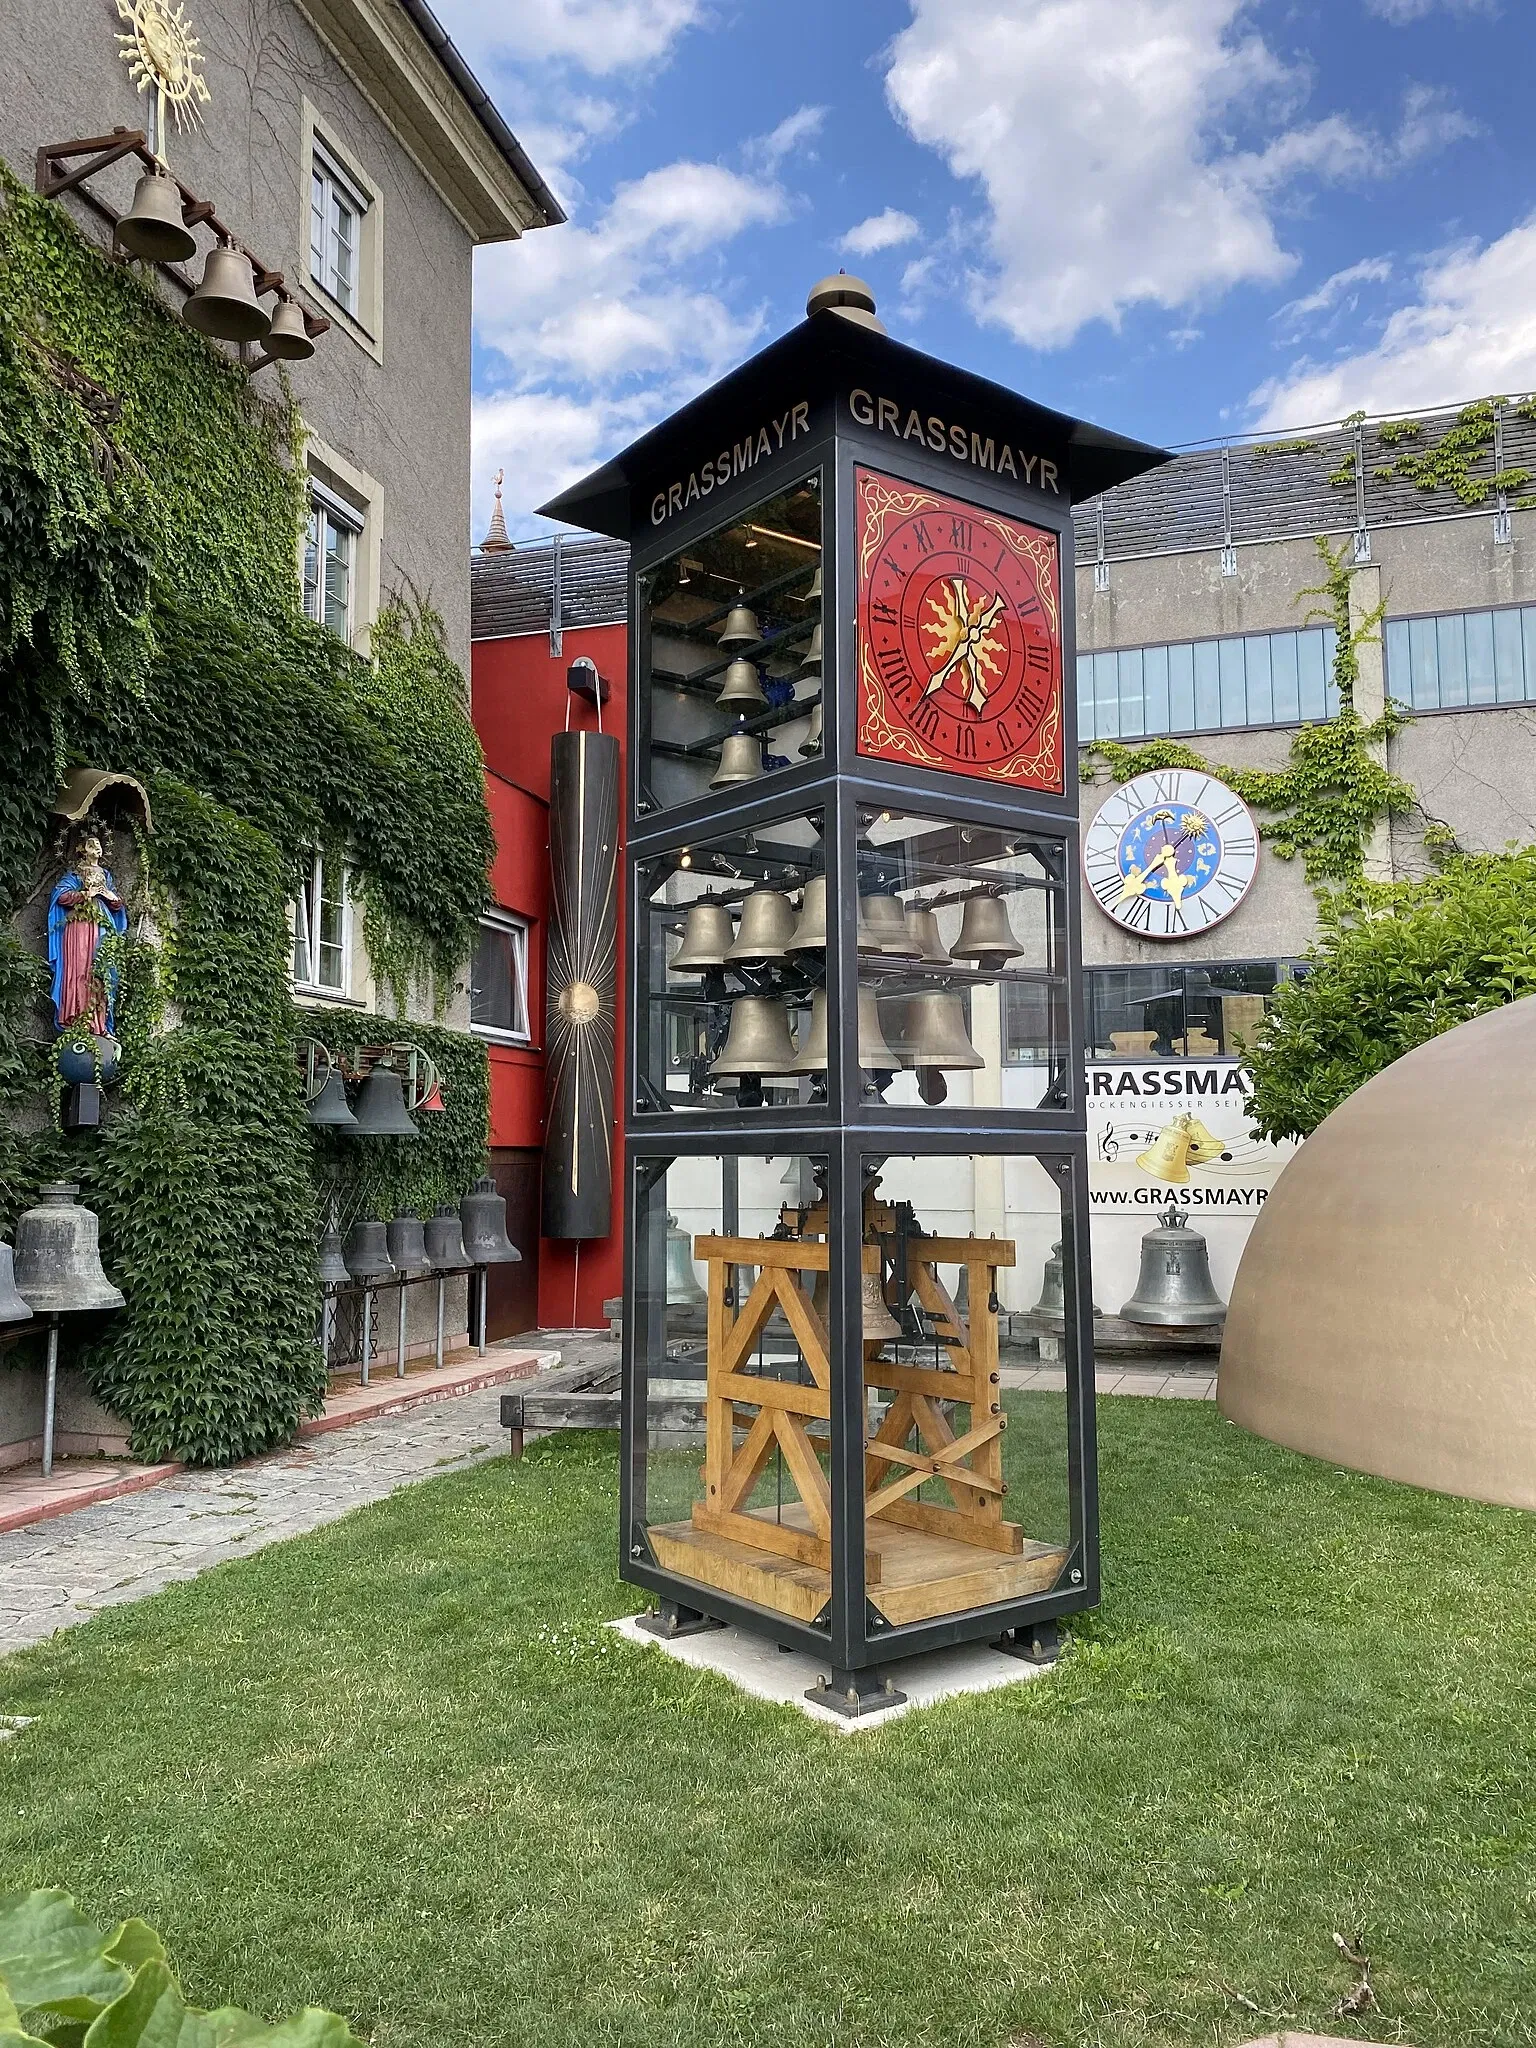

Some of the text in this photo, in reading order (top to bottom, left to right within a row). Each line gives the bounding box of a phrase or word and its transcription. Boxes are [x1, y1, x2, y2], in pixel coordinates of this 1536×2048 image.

[849, 388, 1059, 494] GRASSMAYR
[651, 400, 810, 526] GRASSMAYR
[912, 518, 934, 553] XI
[949, 517, 973, 552] XII
[882, 553, 907, 582] X
[994, 548, 1006, 572] I
[871, 597, 899, 626] IX
[1017, 596, 1041, 617] II
[1027, 644, 1050, 673] III
[955, 723, 977, 760] VI
[996, 720, 1015, 752] V
[1114, 784, 1147, 819] XI
[1150, 772, 1182, 804] XII
[1193, 779, 1211, 806] I
[1093, 813, 1126, 839] X
[1212, 801, 1245, 827] II
[1087, 844, 1118, 869] IX
[1224, 837, 1255, 858] III
[1215, 871, 1249, 902] IV
[1121, 896, 1152, 931] VII
[1164, 904, 1190, 934] VI
[1198, 896, 1222, 924] V
[1085, 1069, 1257, 1096] RASSMA
[1088, 1100, 1238, 1109] OCKENGIESSER SEI
[1090, 1187, 1269, 1205] ww.GRASSMAYR
